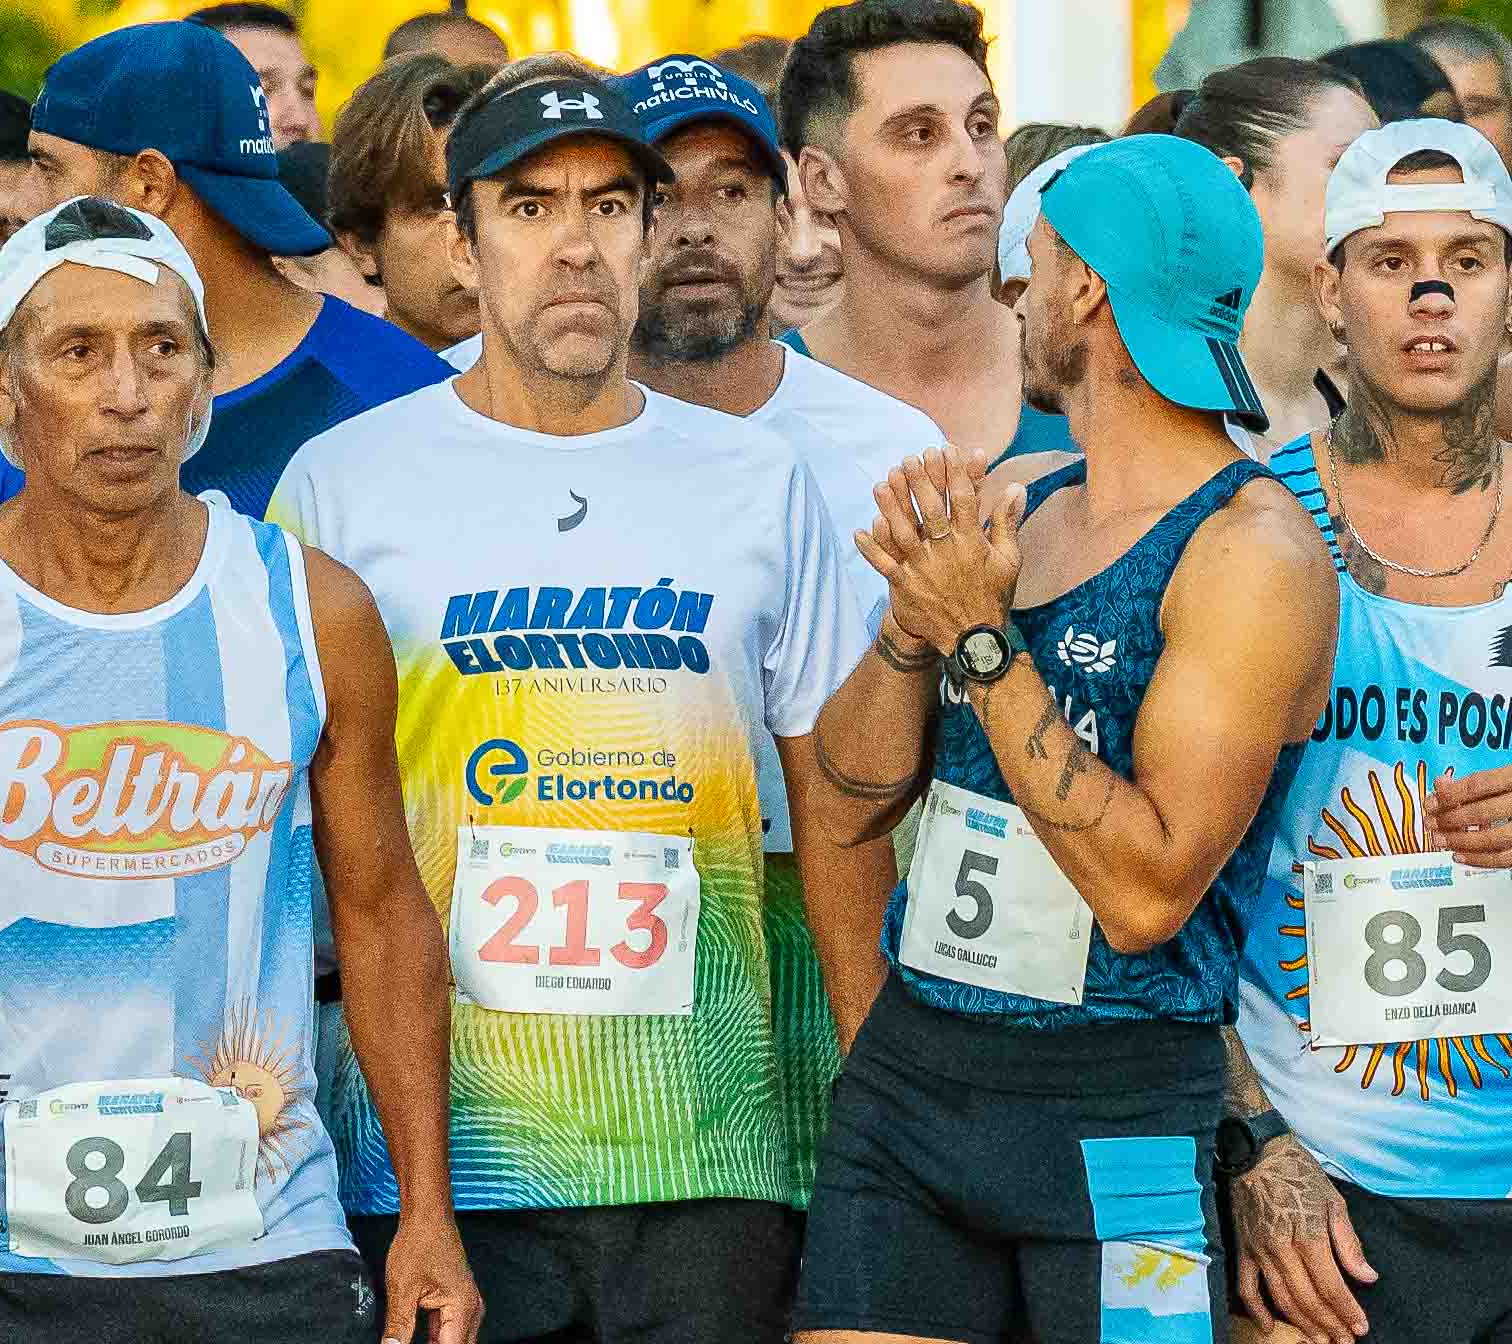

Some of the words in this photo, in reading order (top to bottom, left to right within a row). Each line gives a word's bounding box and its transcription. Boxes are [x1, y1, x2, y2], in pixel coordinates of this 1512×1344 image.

[440, 578, 715, 639] MARATÓN
[442, 633, 710, 675] ELORTONDO
[495, 678, 521, 696] 137
[529, 677, 667, 694] ANIVERSARIO
[1396, 687, 1428, 744] ES
[537, 748, 645, 767] Gobierno
[652, 748, 676, 767] de
[538, 774, 694, 803] Elortondo
[52, 841, 235, 871] SUPERMERCADOS
[945, 849, 999, 940] 5
[478, 875, 670, 969] 213
[934, 941, 958, 959] LUCAS
[957, 946, 997, 969] GALLUCCI
[1364, 904, 1492, 996] 85
[535, 975, 563, 989] DIEGO
[566, 976, 612, 991] EDUARDO
[1385, 1007, 1411, 1021] ENZO
[1413, 1005, 1441, 1020] DELLA
[1443, 1002, 1476, 1017] BIANCA
[65, 1132, 202, 1224] 84
[84, 1234, 108, 1246] JUAN
